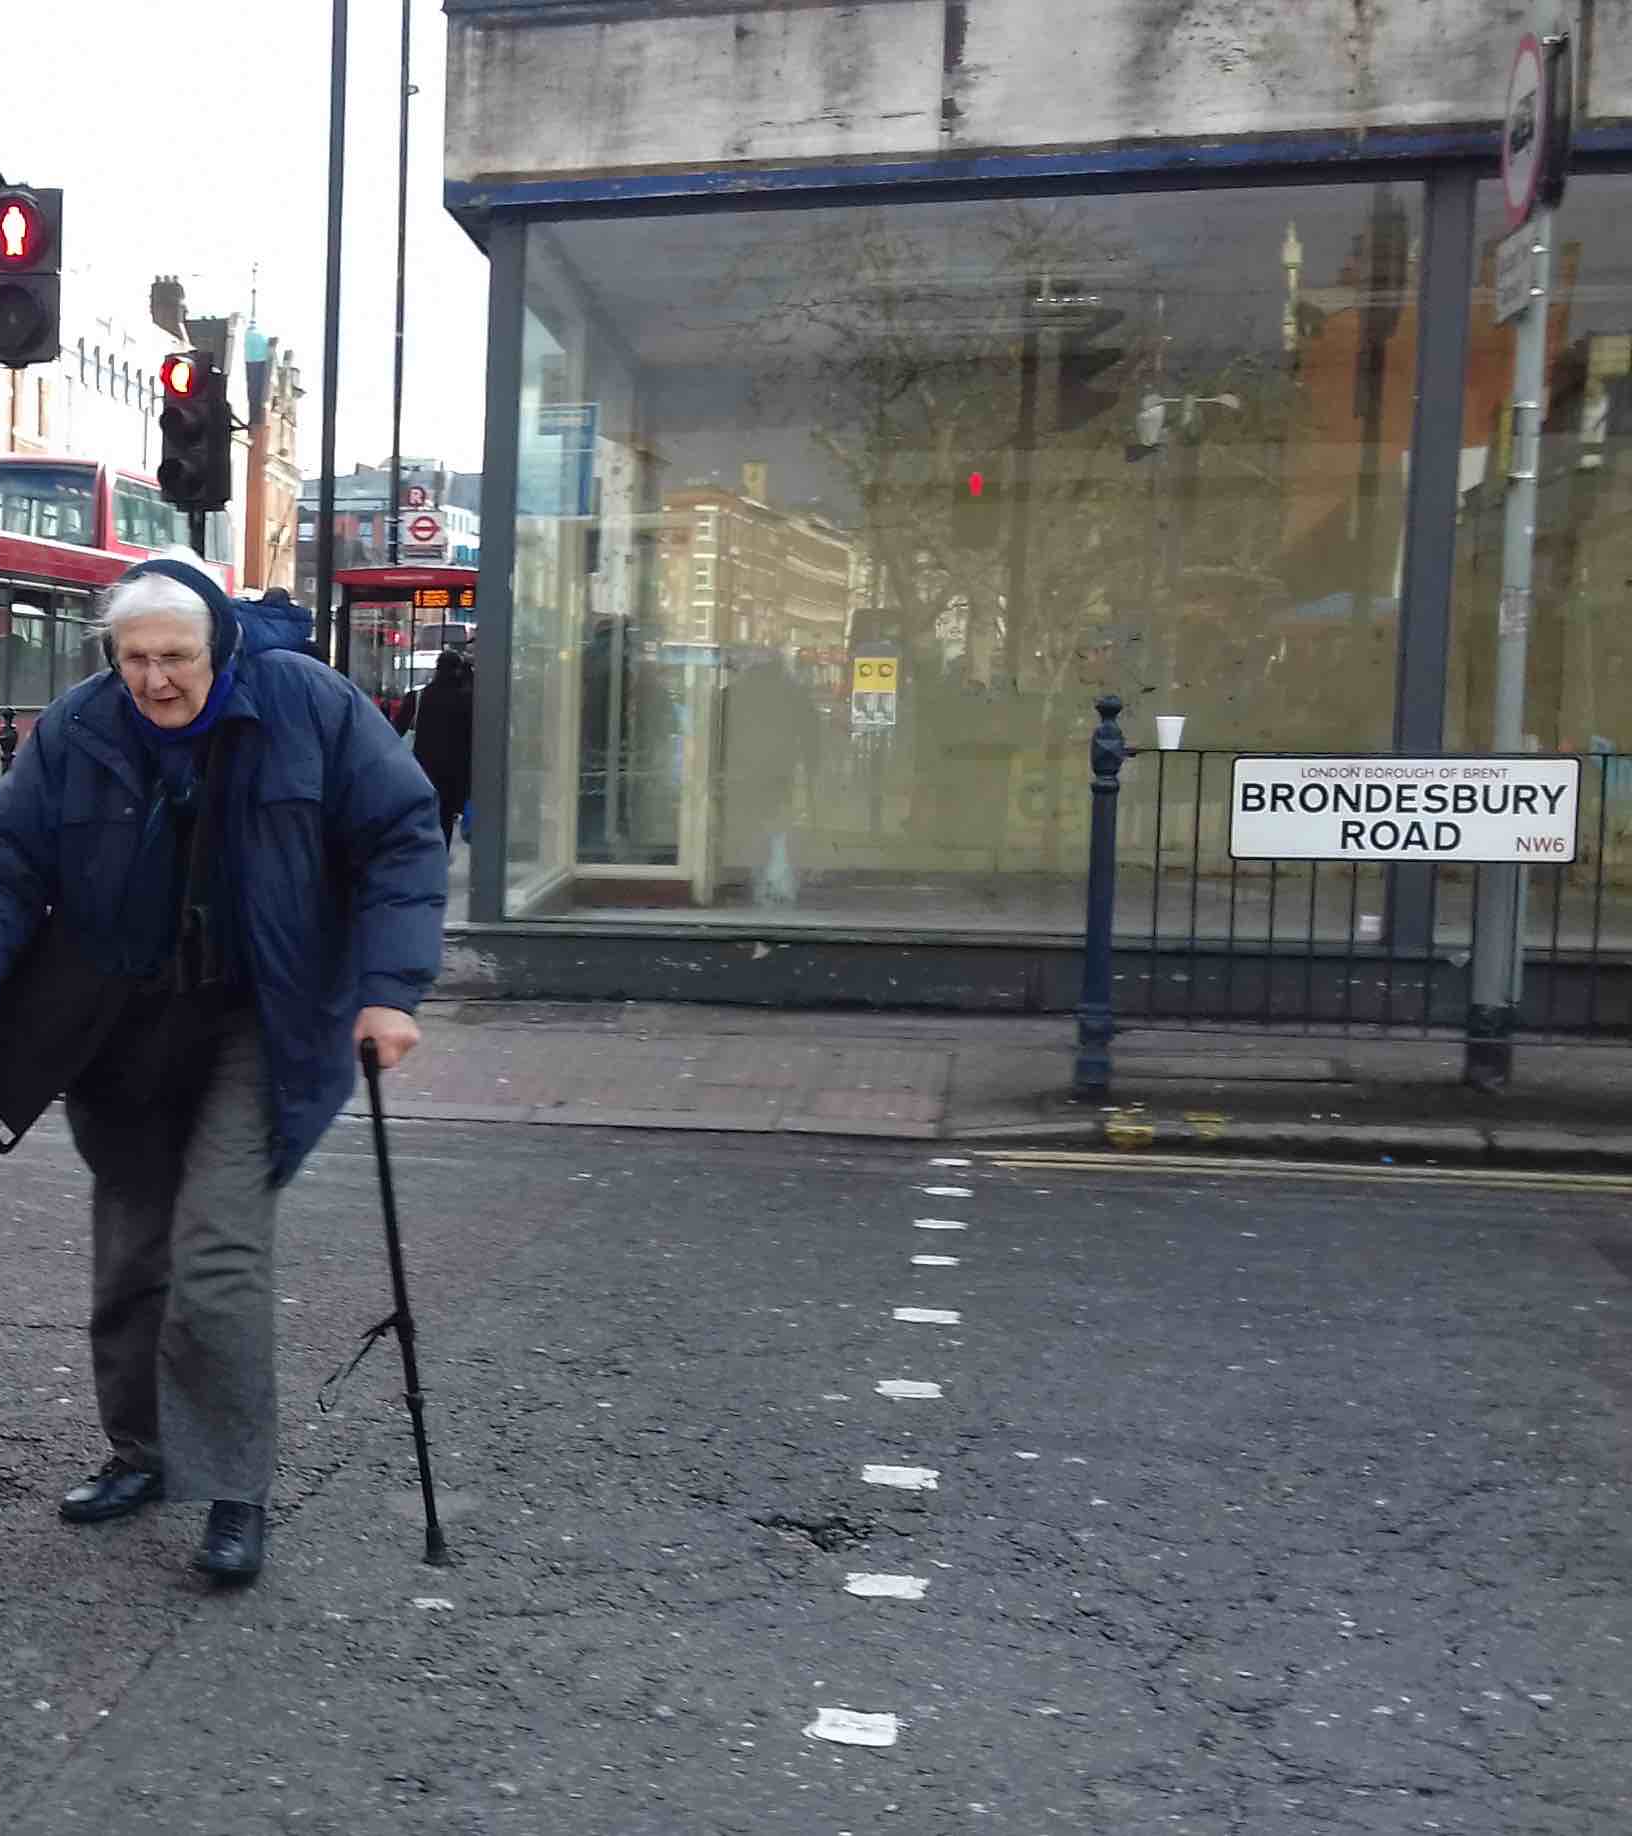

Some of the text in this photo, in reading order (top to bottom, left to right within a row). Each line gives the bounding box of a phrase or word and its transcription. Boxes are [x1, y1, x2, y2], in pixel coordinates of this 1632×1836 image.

[1301, 768, 1508, 779] LONDON BOROUGH OF BRENT
[1240, 782, 1568, 815] BRONDESBURY
[1340, 819, 1462, 851] ROAD
[1515, 836, 1566, 853] NW6
